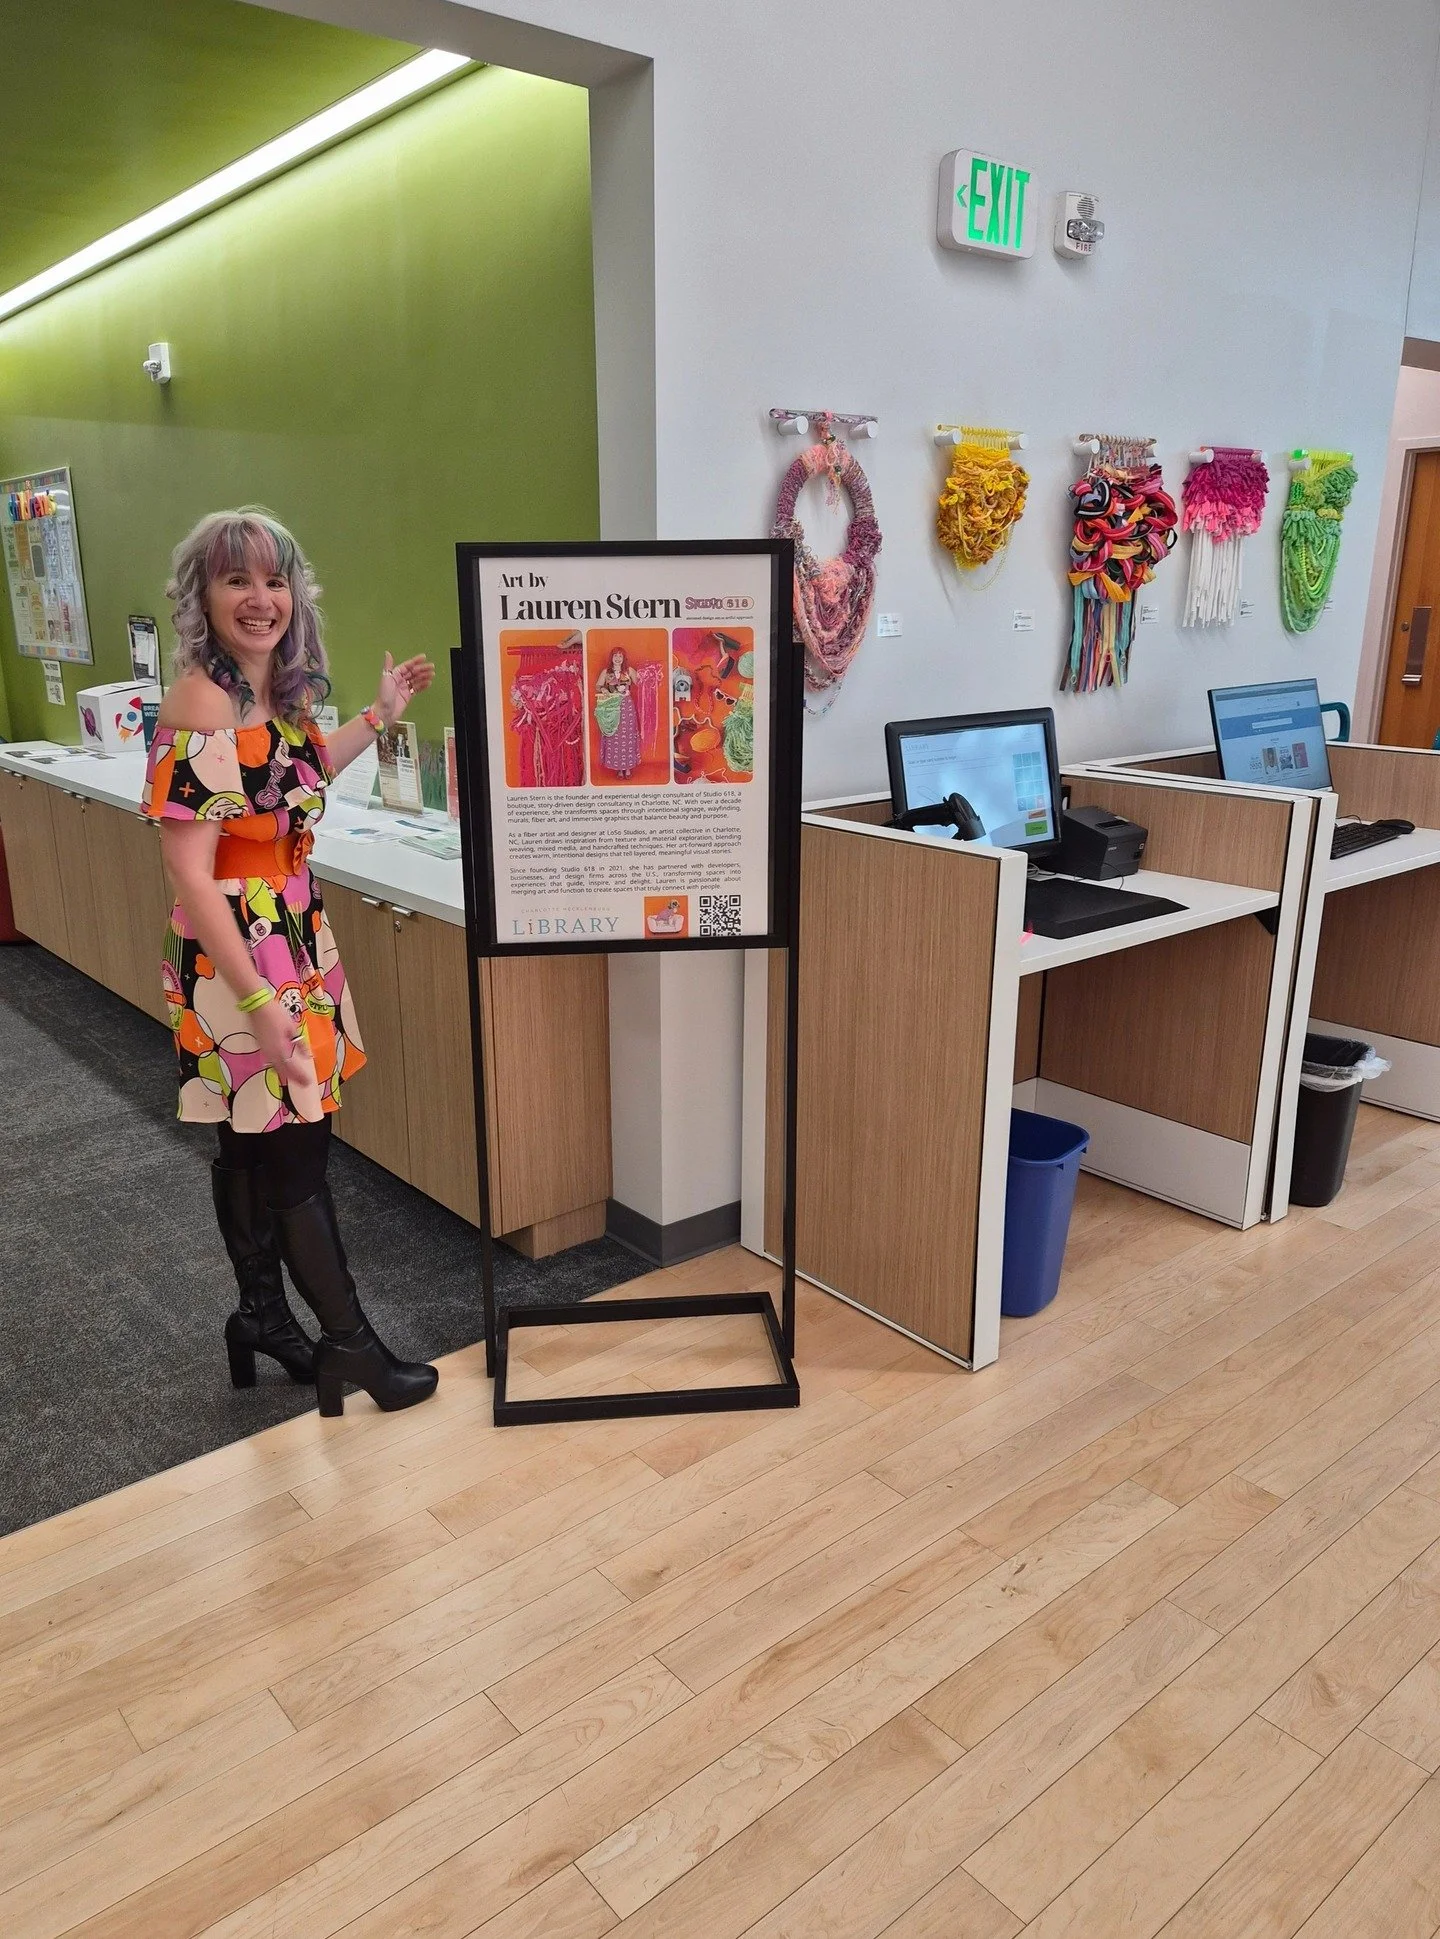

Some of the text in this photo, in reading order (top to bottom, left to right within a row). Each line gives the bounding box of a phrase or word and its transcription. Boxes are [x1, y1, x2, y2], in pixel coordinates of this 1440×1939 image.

[968, 157, 1031, 250] EXIT
[1075, 242, 1092, 252] FIRE
[498, 572, 549, 592] Art by
[499, 593, 681, 621] Lauren Stern
[727, 598, 748, 609] 618
